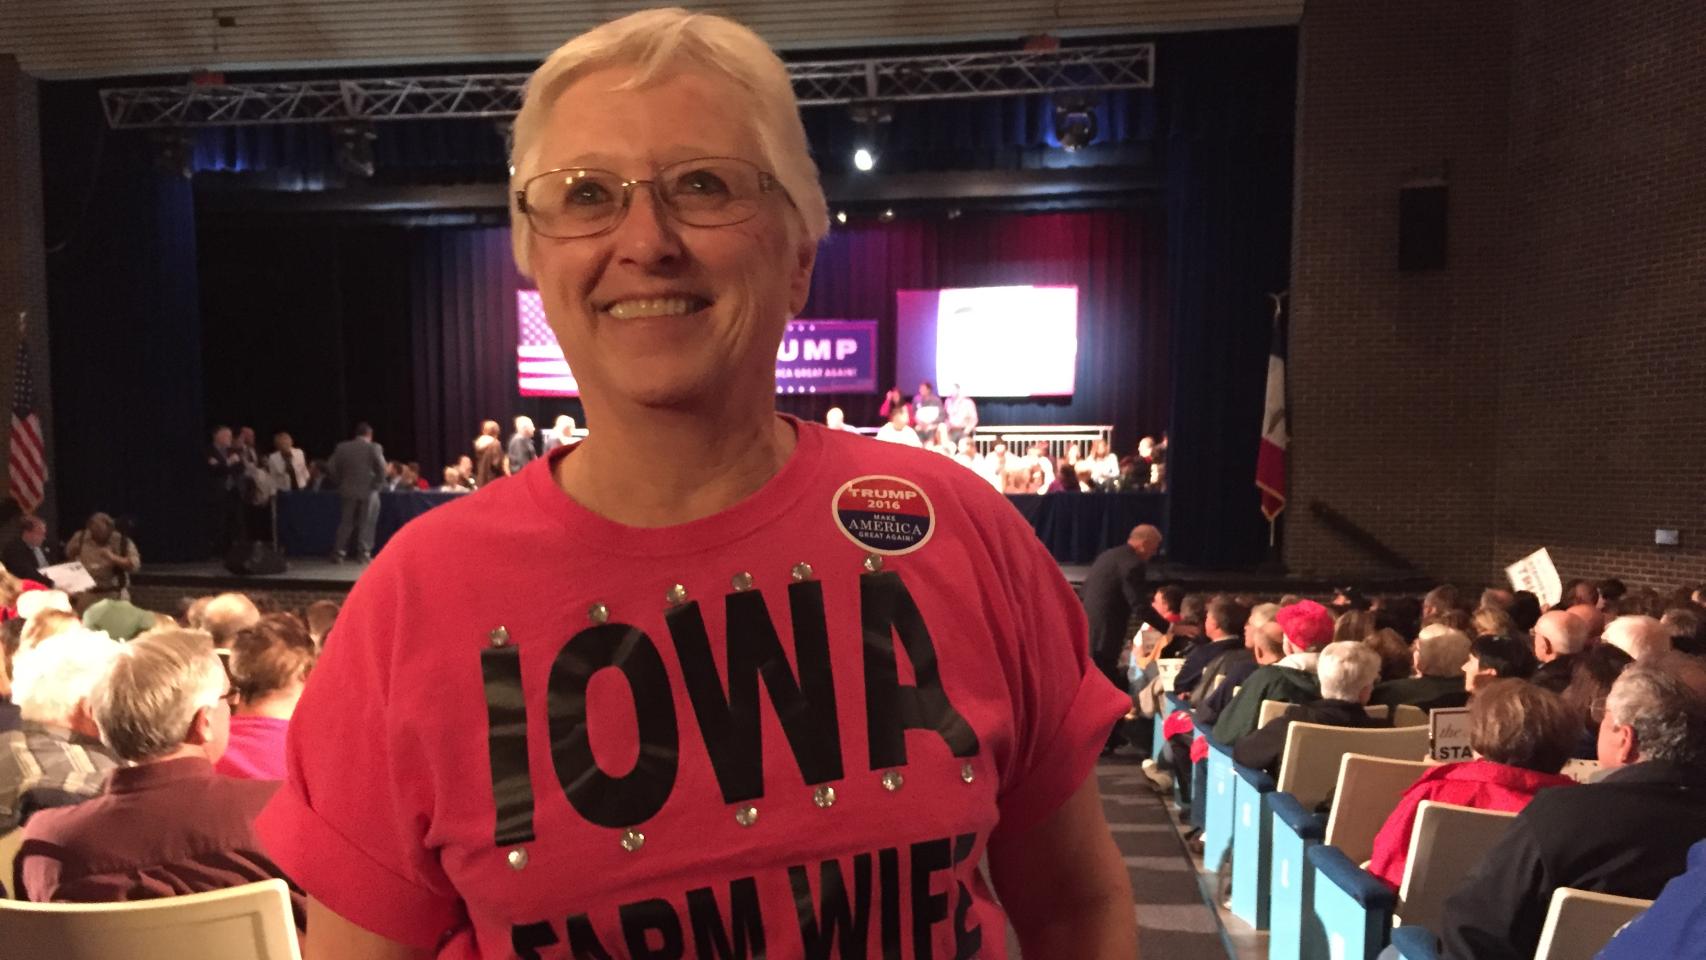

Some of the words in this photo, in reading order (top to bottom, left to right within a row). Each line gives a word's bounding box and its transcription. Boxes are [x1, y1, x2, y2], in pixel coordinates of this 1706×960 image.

[848, 488, 917, 500] TRUMP
[867, 500, 901, 510] 2016
[874, 514, 896, 522] MAKE
[849, 519, 922, 536] AMERICA
[858, 531, 884, 540] GREAT
[886, 532, 914, 542] AGAIN!
[480, 571, 981, 847] IOWA
